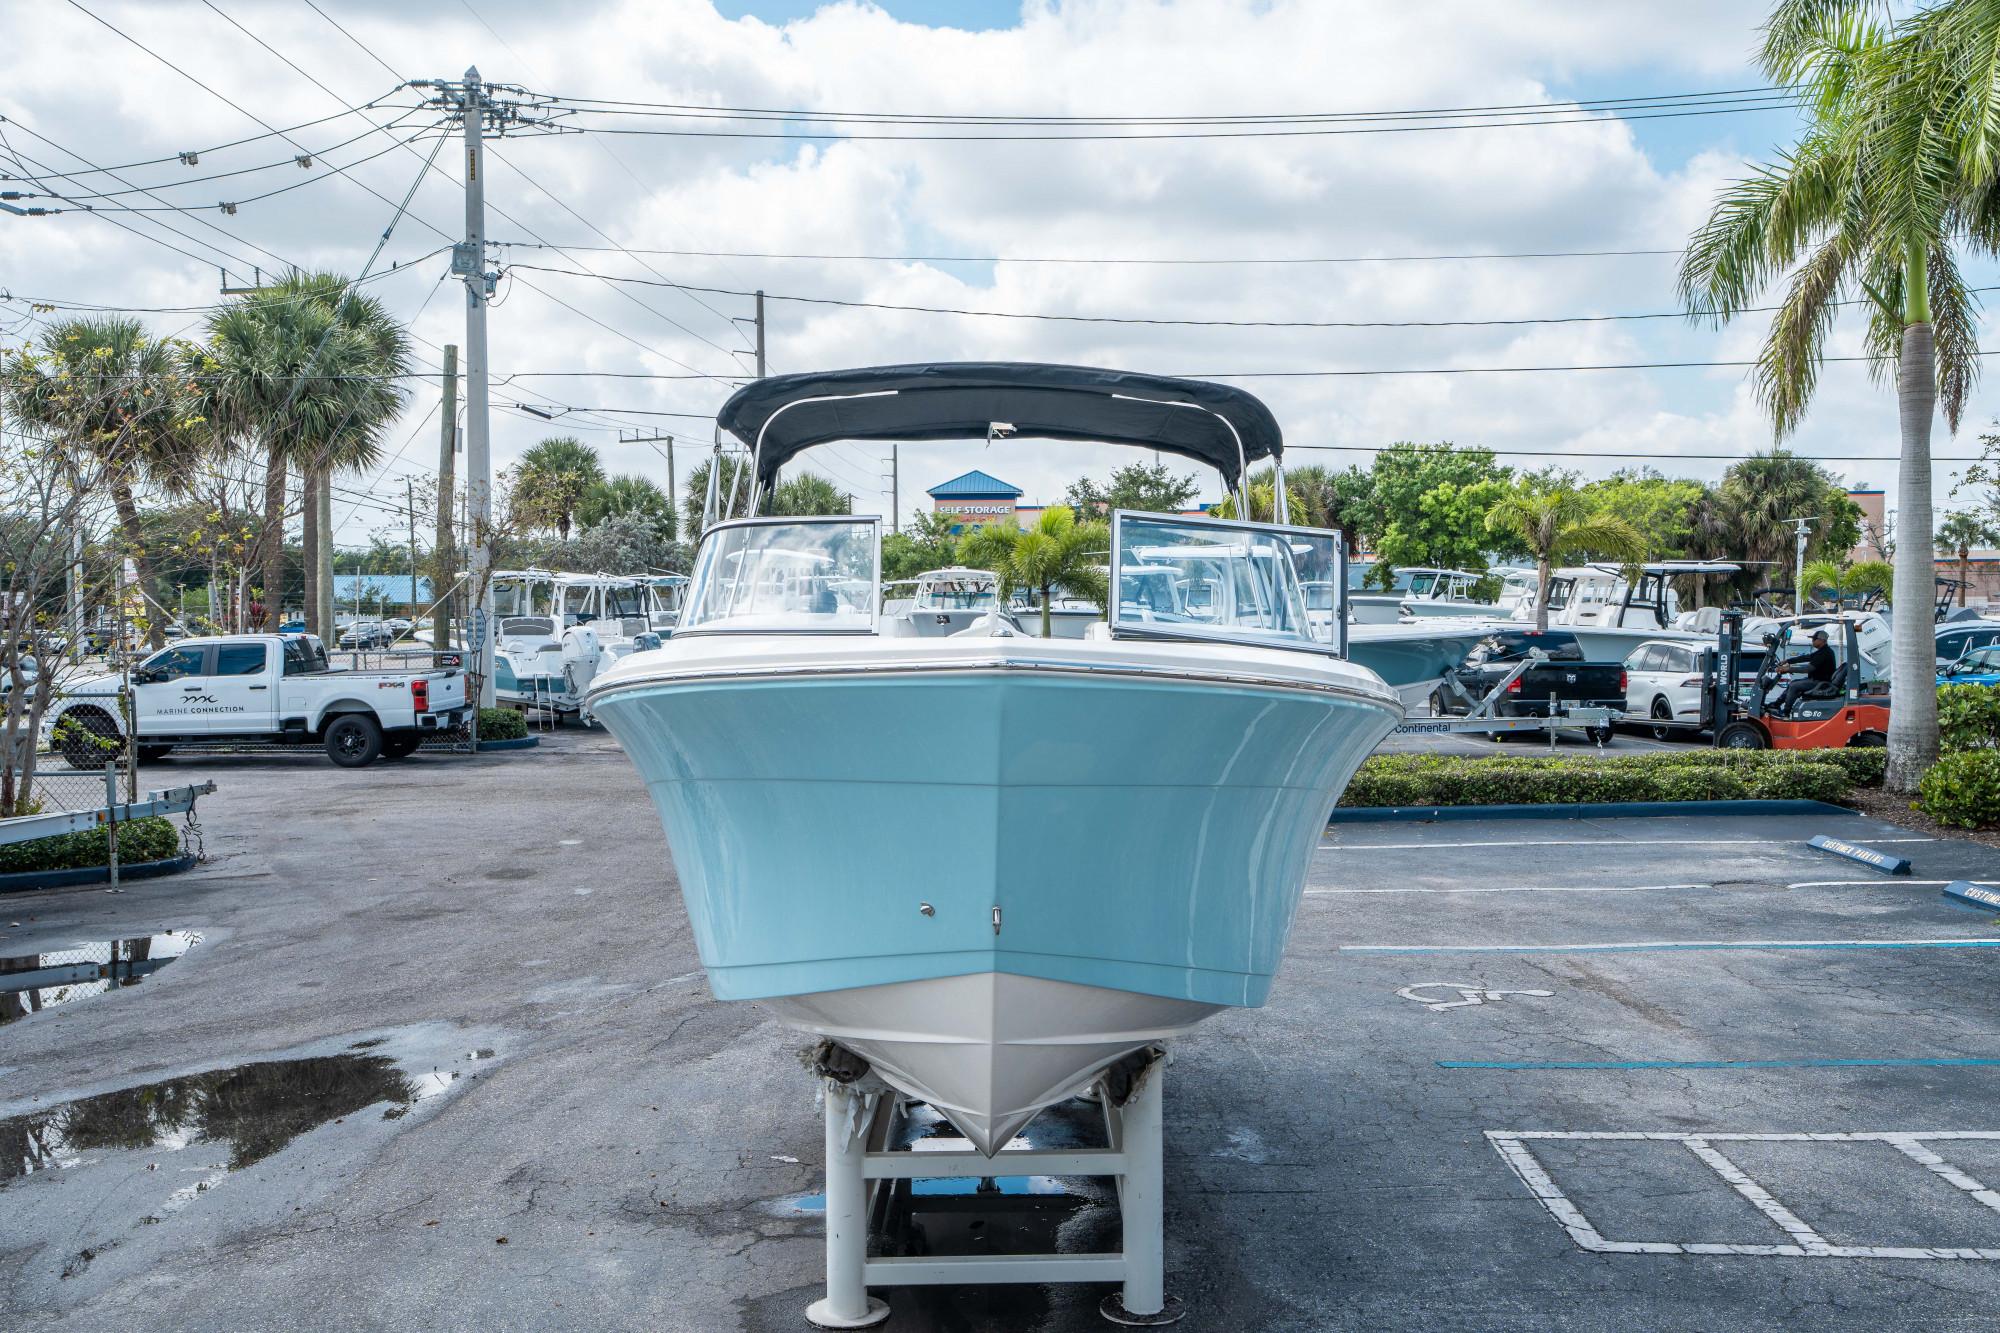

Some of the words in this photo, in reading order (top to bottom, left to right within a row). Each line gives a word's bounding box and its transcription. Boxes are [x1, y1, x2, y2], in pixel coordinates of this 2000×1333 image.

[939, 506, 962, 514] SELF
[964, 506, 1010, 514] STORAGE
[1720, 654, 1728, 685] WORLD
[156, 708, 188, 716] MARINE
[190, 705, 245, 714] CONNECTION
[1396, 723, 1451, 734] Continental
[1822, 840, 1854, 854] CUSTOMER
[1853, 849, 1884, 864] PARKING
